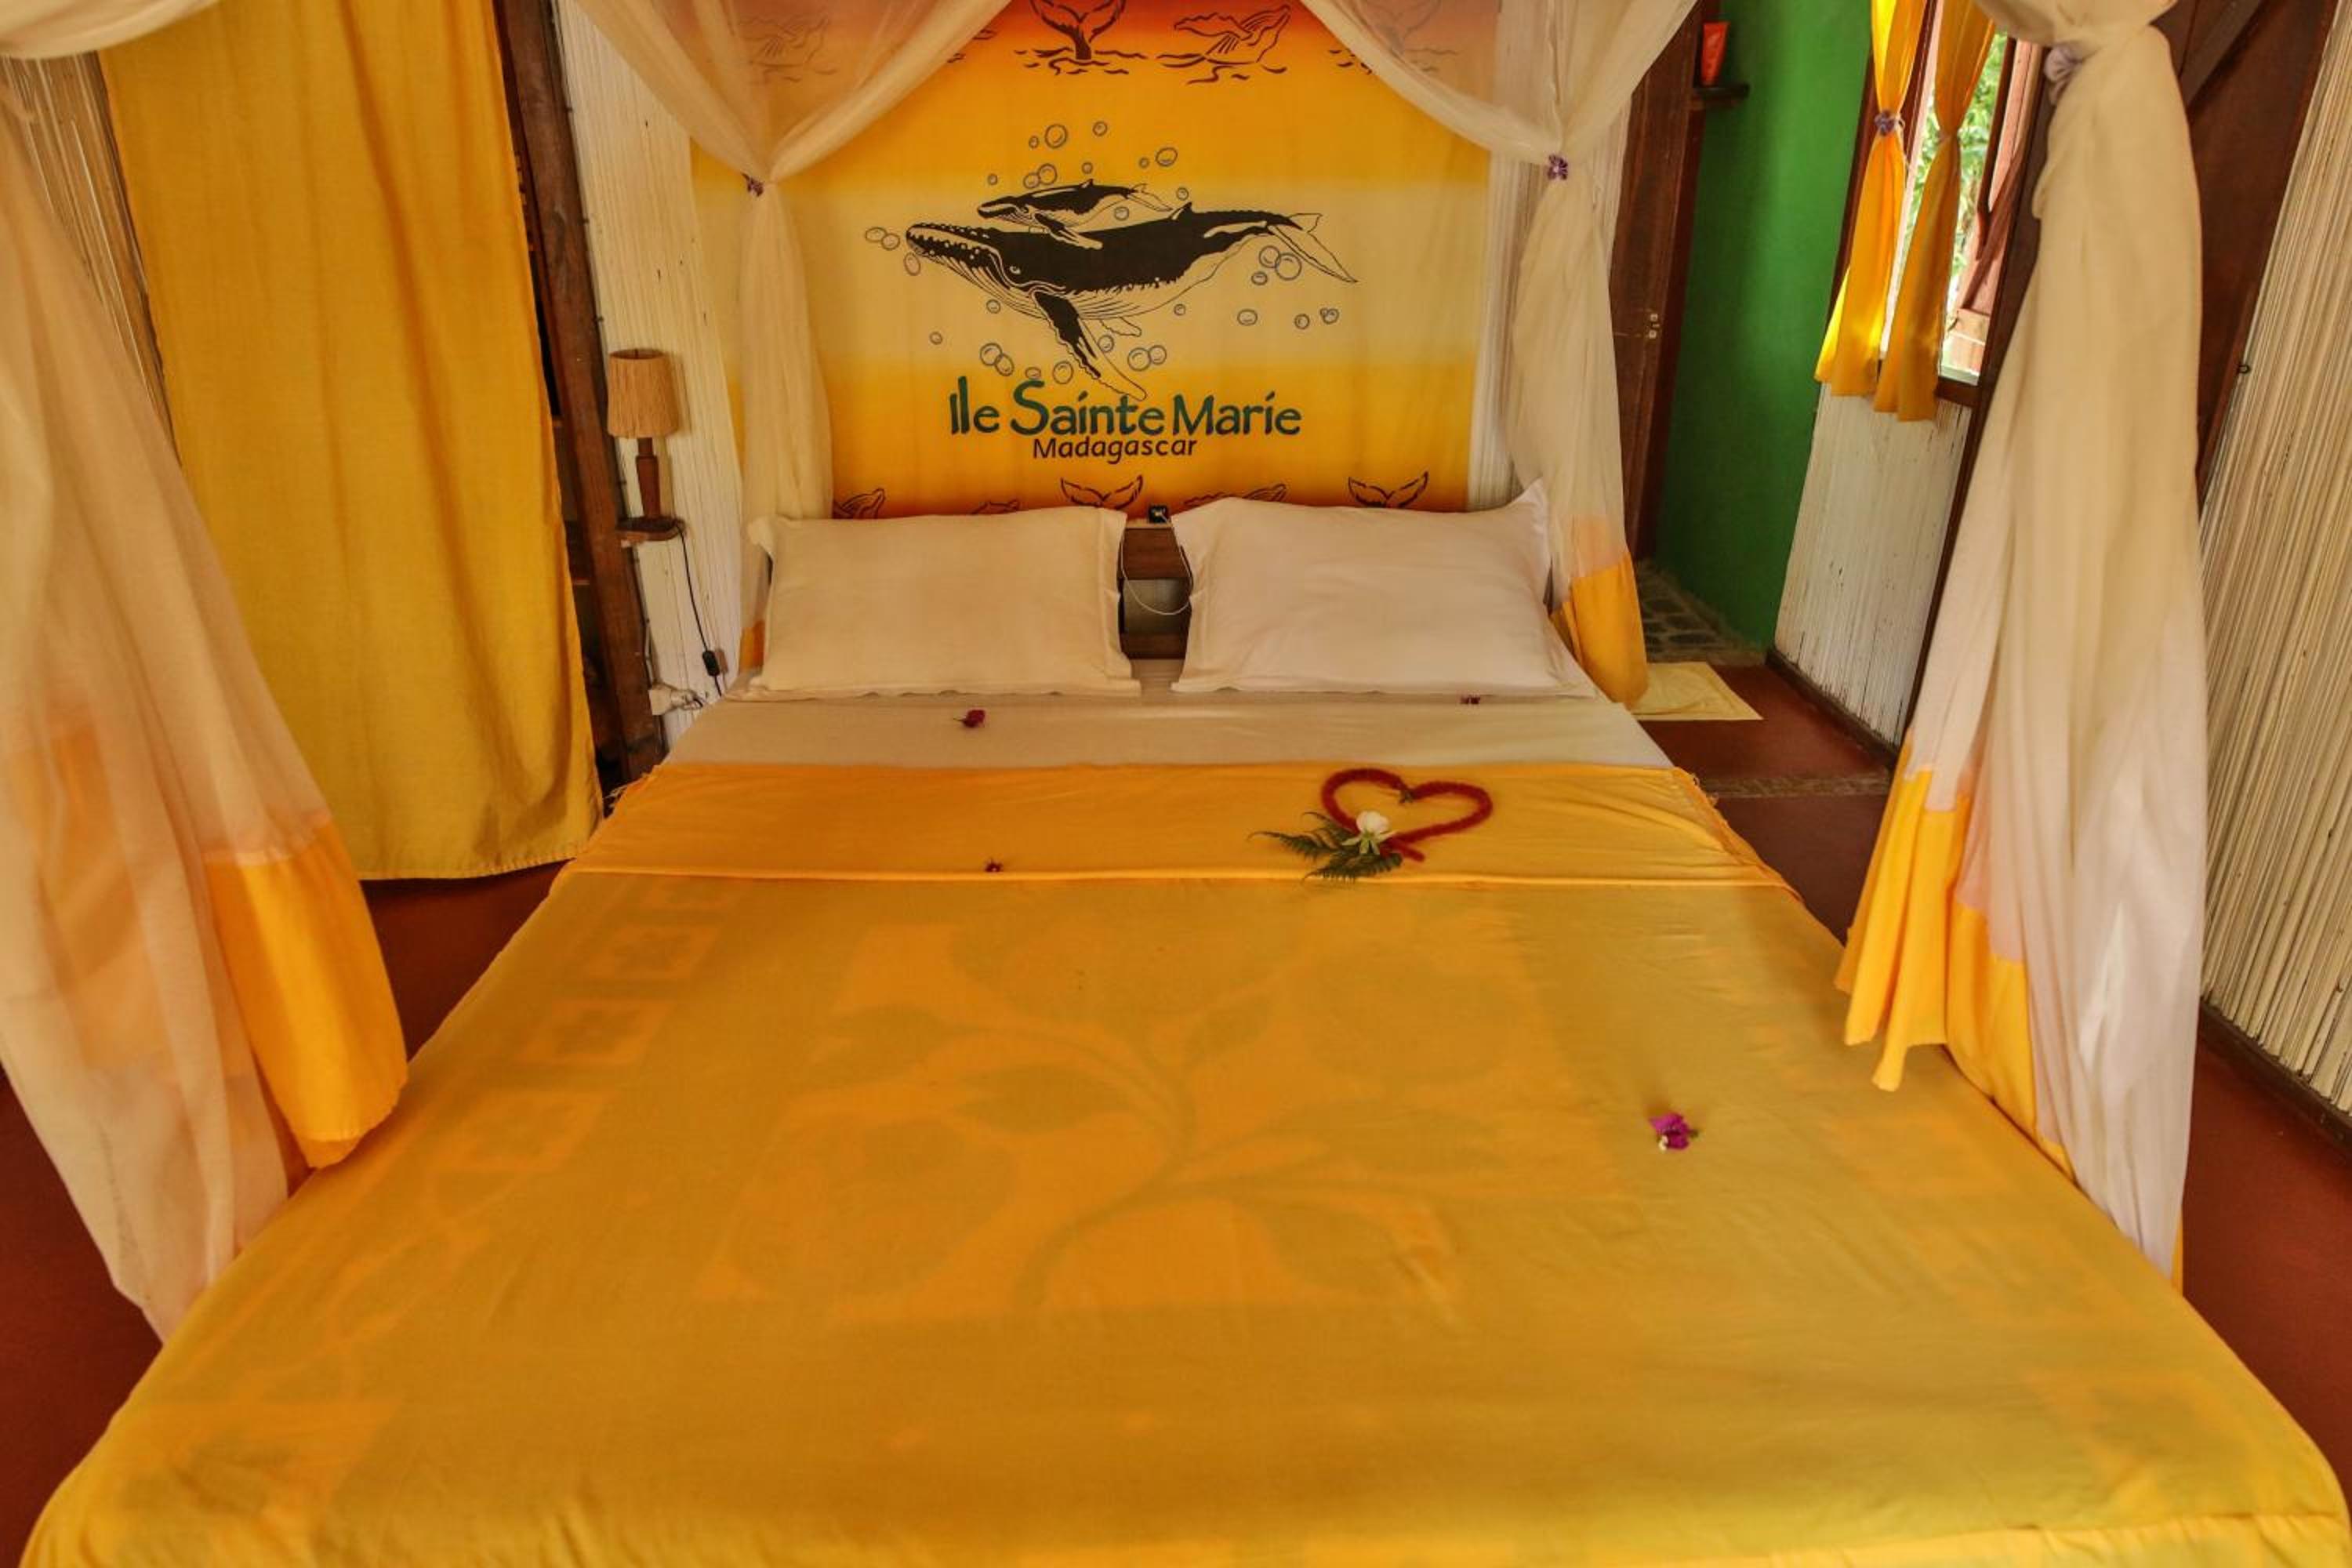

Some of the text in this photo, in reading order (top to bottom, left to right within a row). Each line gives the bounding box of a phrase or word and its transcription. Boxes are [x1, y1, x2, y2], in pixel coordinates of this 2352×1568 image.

[949, 376, 1302, 436] Ile Sainte Marie
[1032, 436, 1198, 464] Madagascar
